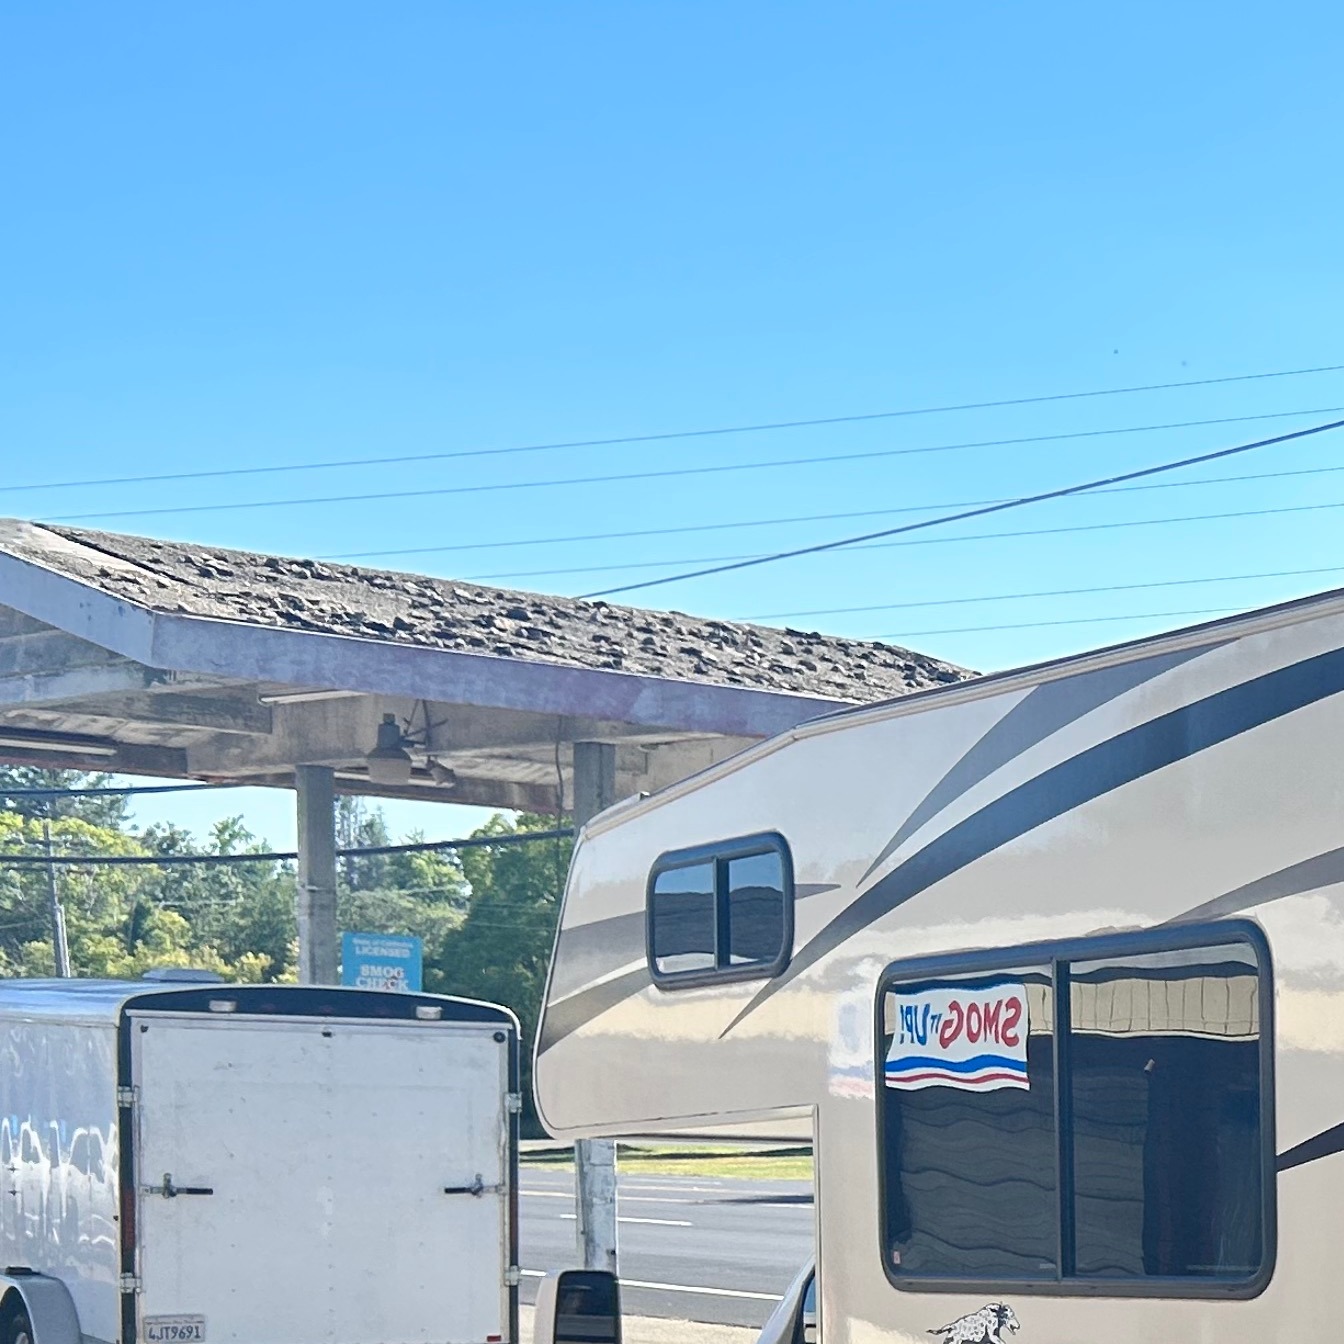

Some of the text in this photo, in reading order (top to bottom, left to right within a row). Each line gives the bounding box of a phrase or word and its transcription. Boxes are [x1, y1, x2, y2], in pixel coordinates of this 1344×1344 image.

[355, 945, 410, 958] LICENSED
[361, 964, 404, 978] SMOG
[356, 976, 409, 992] CHECK
[148, 1324, 201, 1341] 4JT9691
